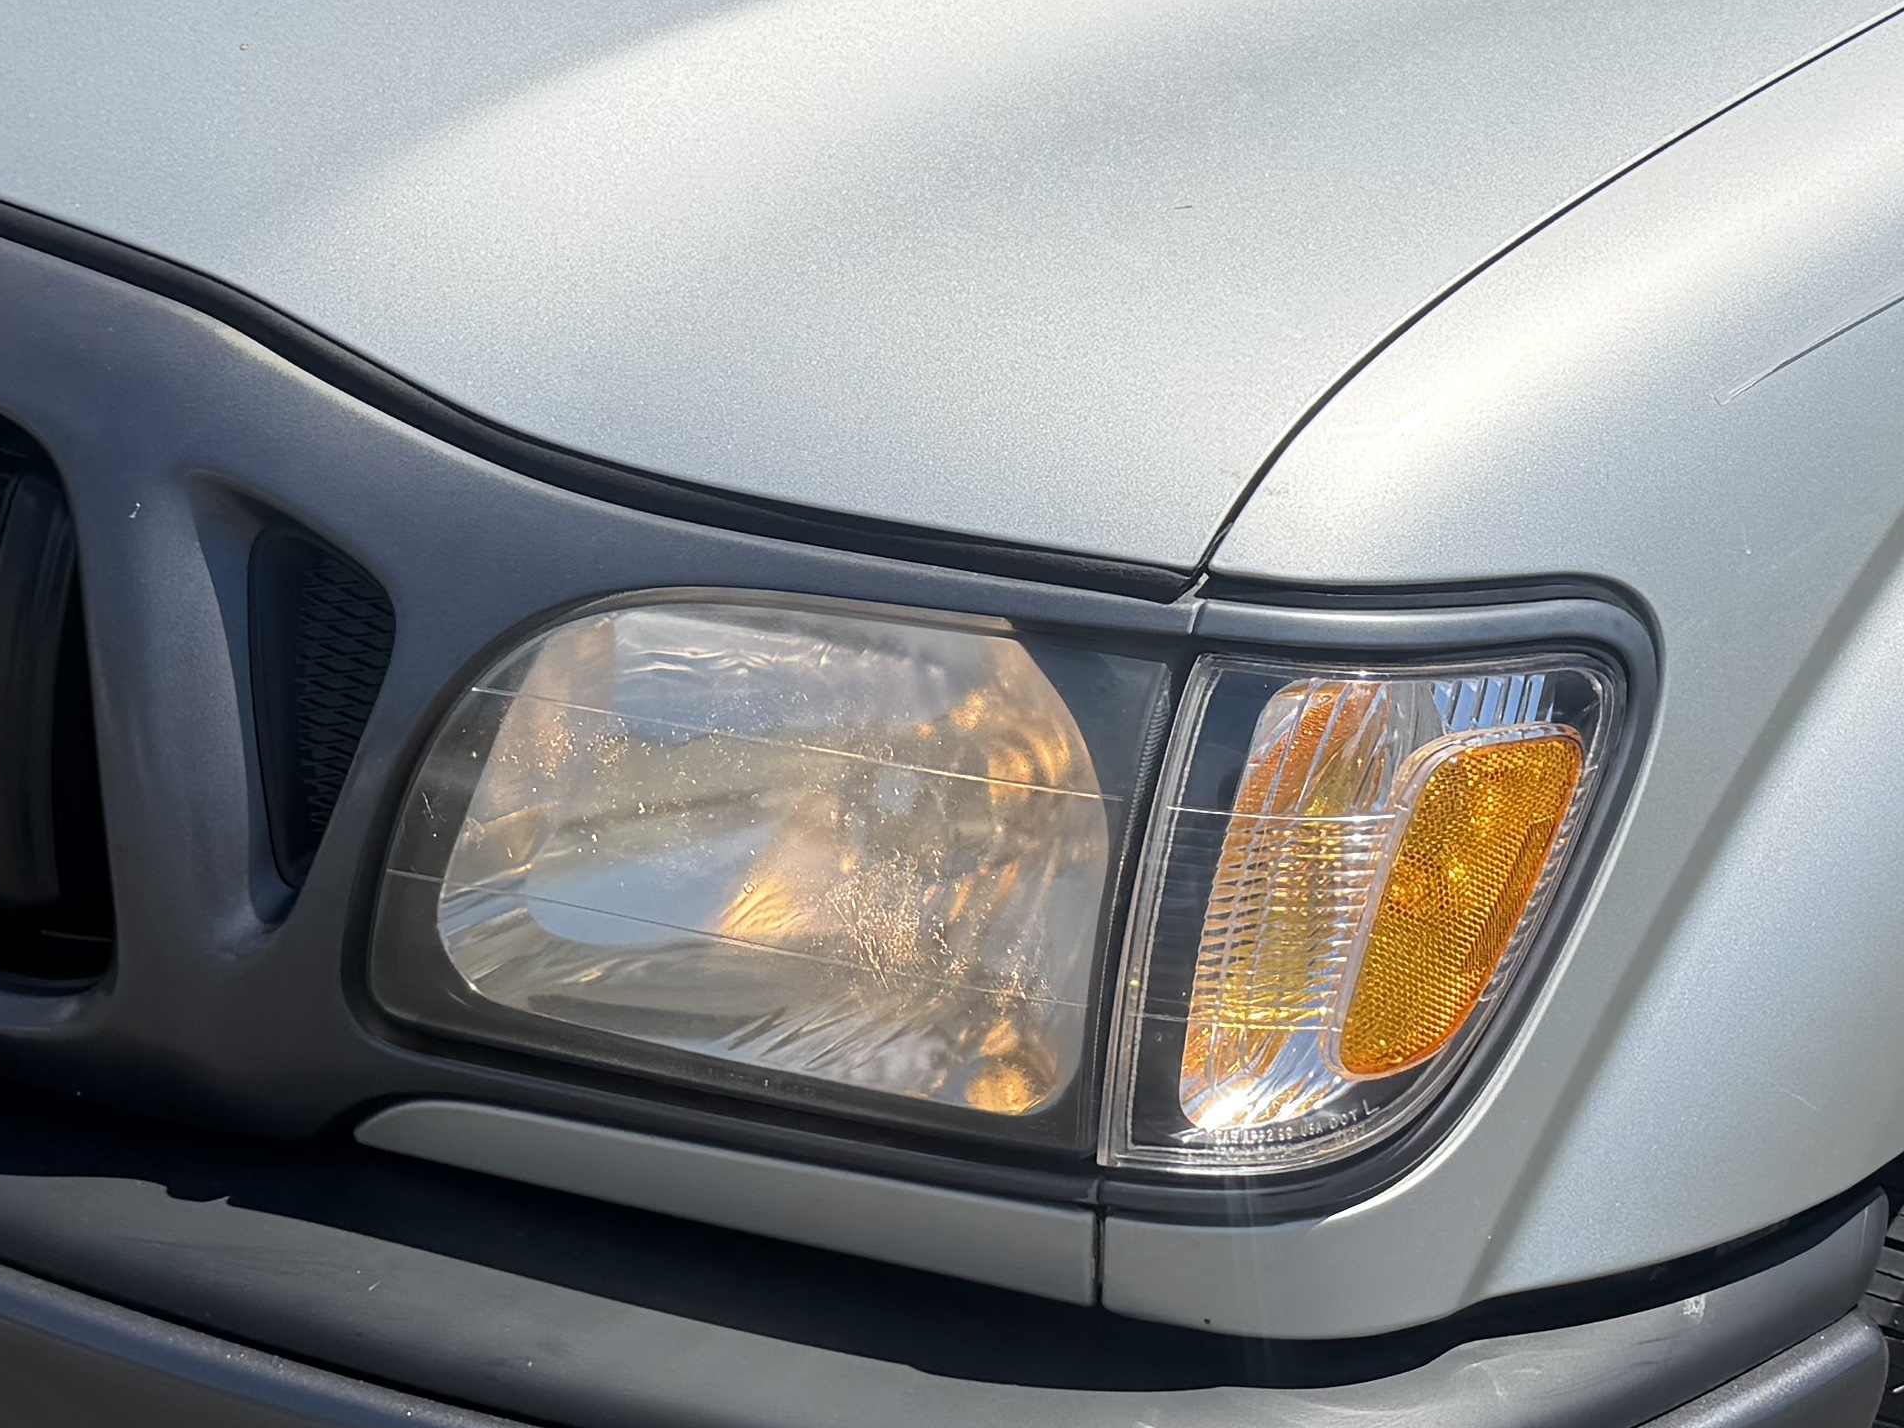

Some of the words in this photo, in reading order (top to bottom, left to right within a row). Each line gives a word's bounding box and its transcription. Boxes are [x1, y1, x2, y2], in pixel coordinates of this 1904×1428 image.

[1300, 1121, 1323, 1138] USA
[1328, 1107, 1358, 1129] DOT
[1362, 1098, 1380, 1116] L
